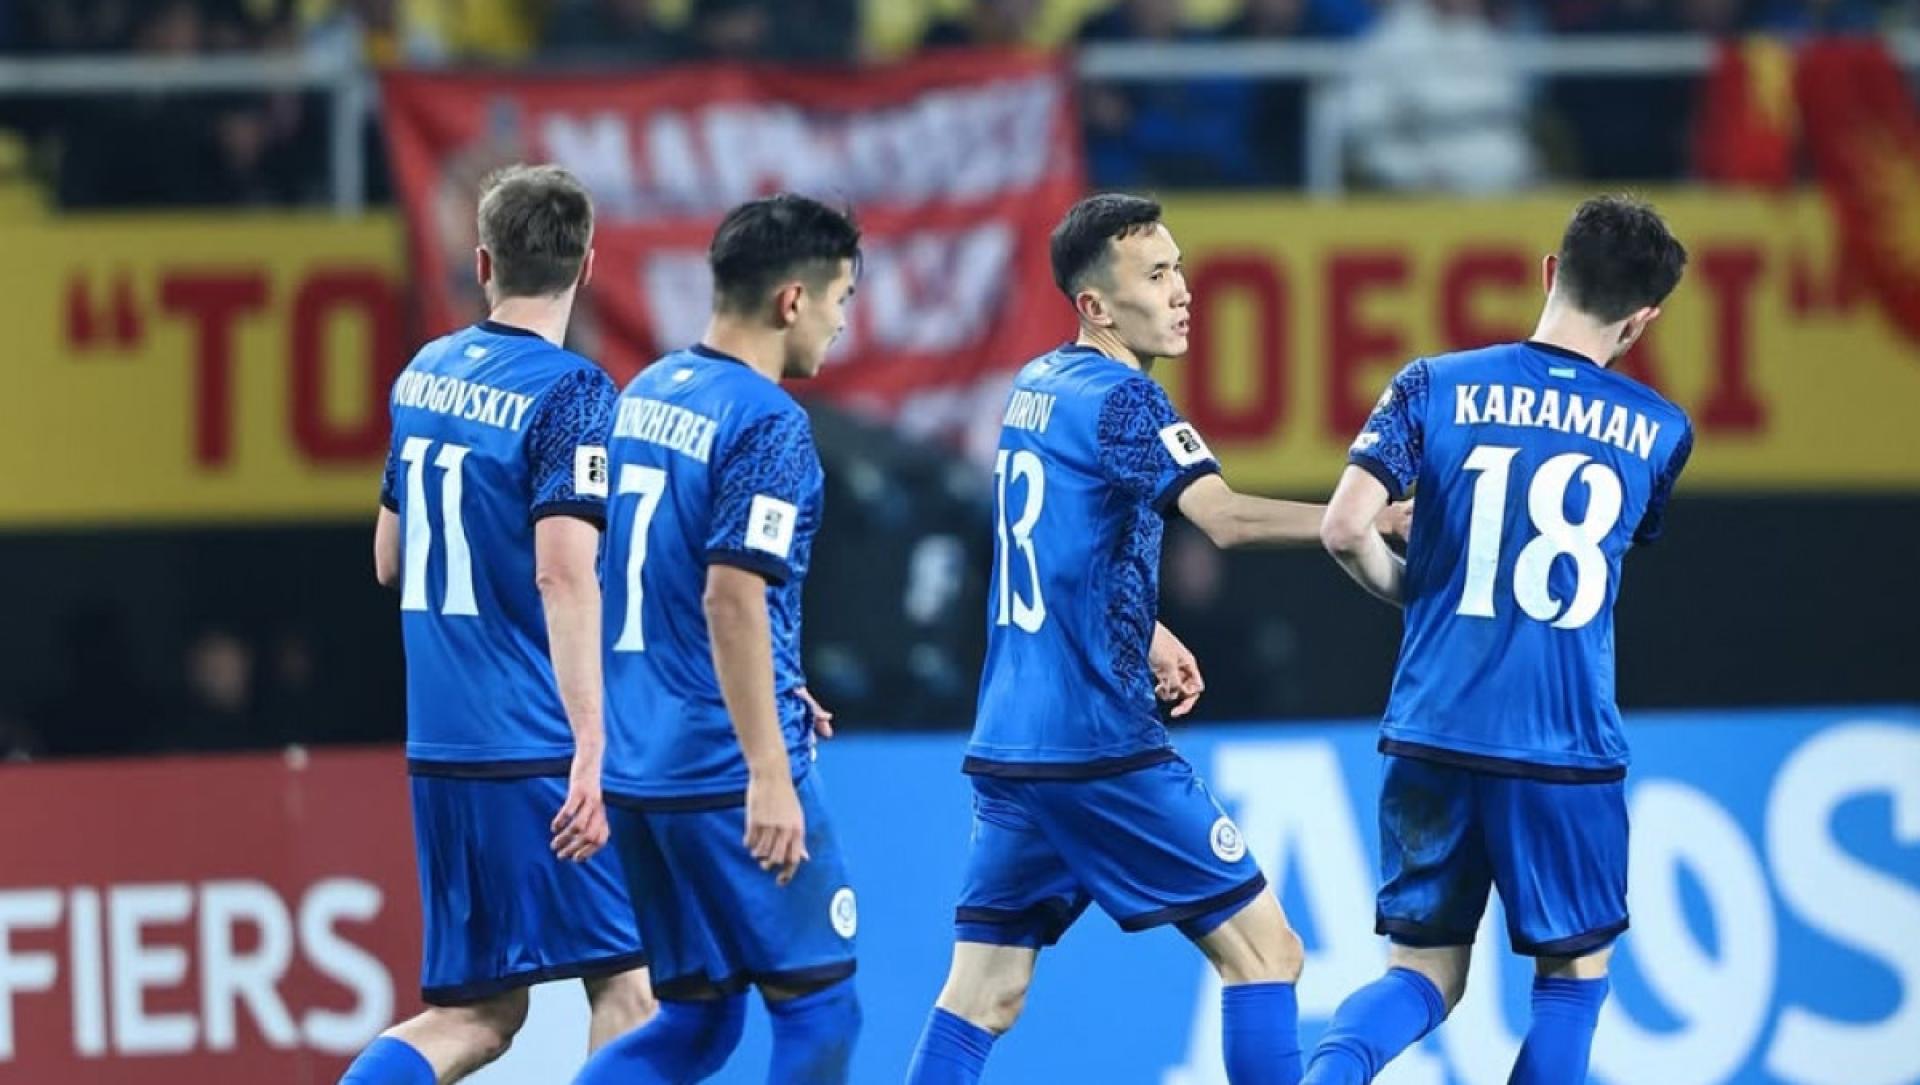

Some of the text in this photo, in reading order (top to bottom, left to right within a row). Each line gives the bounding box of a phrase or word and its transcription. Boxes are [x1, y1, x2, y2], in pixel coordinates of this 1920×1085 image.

[1453, 383, 1661, 461] KARAMAN
[400, 436, 479, 615] 11
[613, 463, 668, 652] 7
[994, 449, 1047, 634] 13
[1456, 444, 1622, 629] 18
[0, 876, 396, 1060] FIERS
